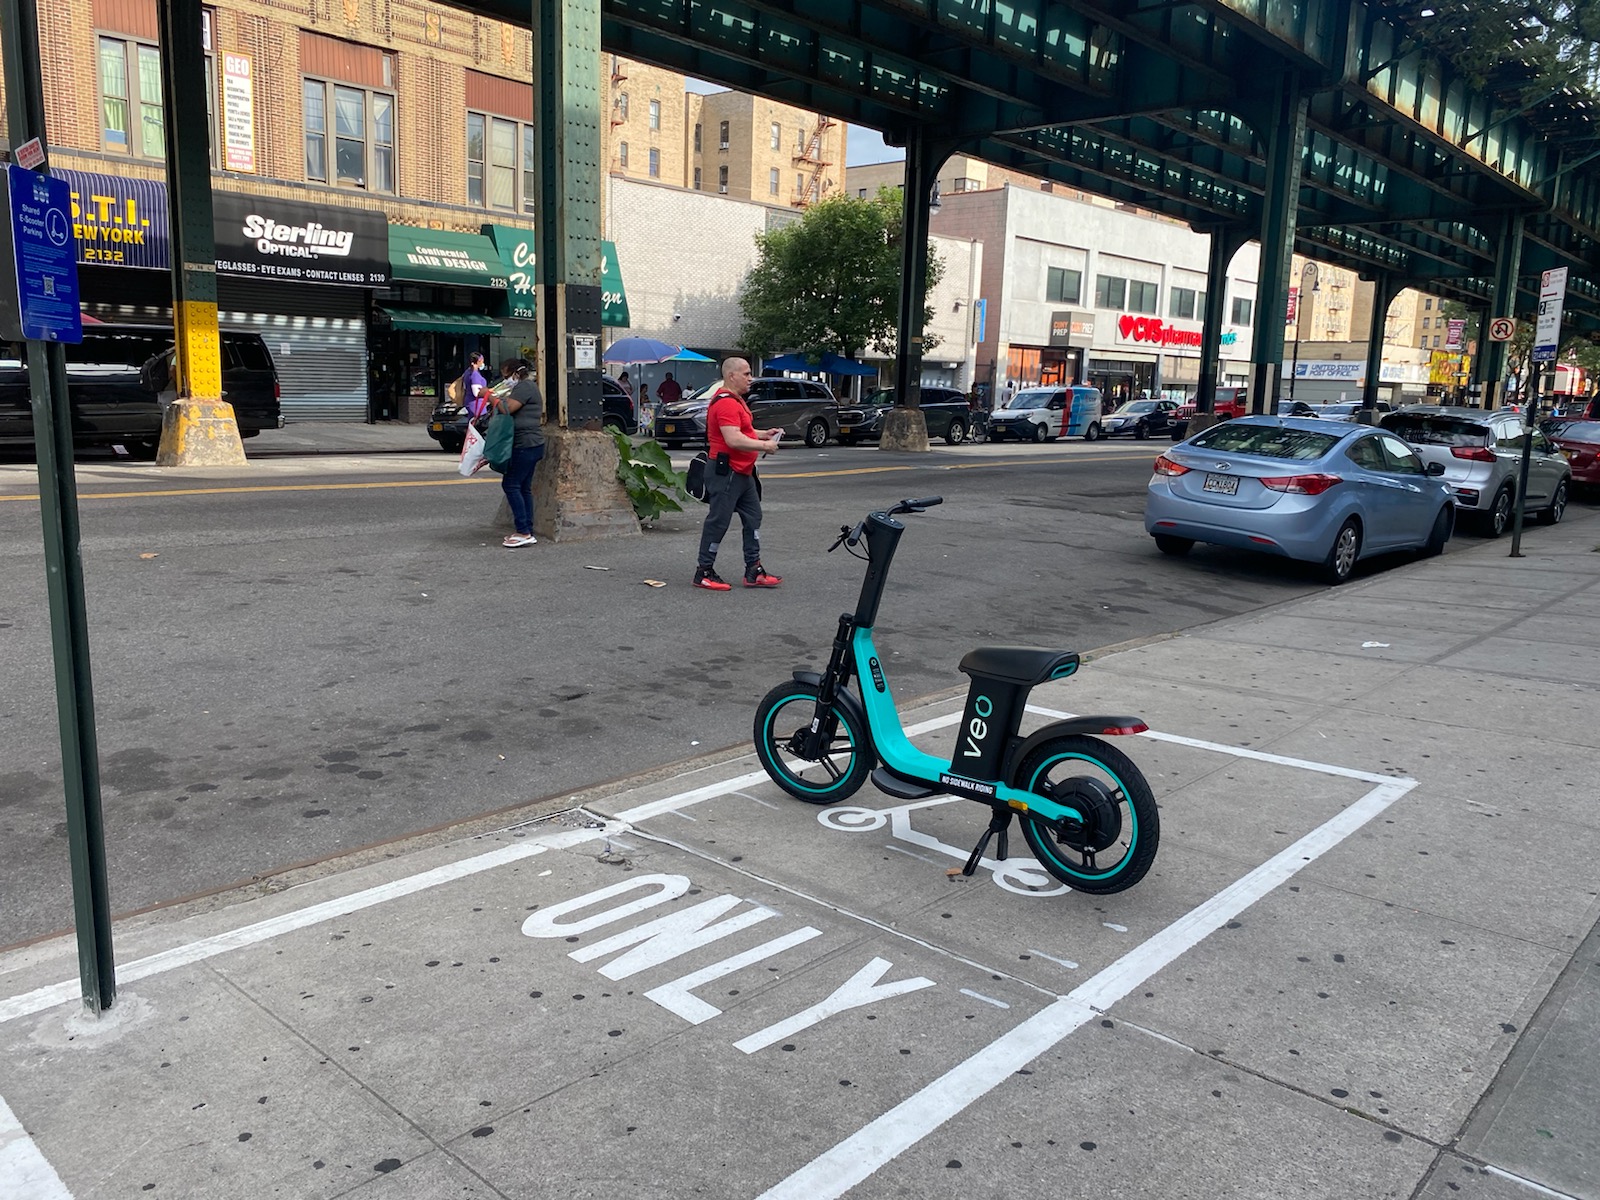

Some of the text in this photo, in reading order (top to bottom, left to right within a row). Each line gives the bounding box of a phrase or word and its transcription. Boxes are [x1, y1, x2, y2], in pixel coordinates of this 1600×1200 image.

[226, 56, 250, 76] GEO
[22, 204, 40, 216] Shared
[19, 214, 45, 228] E-Scooter
[22, 226, 43, 239] Parking
[73, 224, 145, 245] EW YORK
[242, 214, 354, 257] Sterling
[85, 248, 124, 262] 2132
[258, 238, 313, 258] OPTICAL
[416, 246, 470, 259] Continental
[214, 260, 256, 272] EGLASSES
[261, 266, 276, 274] EYE
[276, 267, 301, 277] EXAMS
[306, 270, 338, 280] CONTACT
[338, 272, 364, 282] LENSES
[406, 254, 488, 271] HAIR DESIGN
[370, 273, 386, 282] 2130
[514, 308, 532, 318] 2128
[1132, 316, 1164, 343] CVS
[1162, 325, 1202, 346] pharma
[942, 776, 993, 794] NO SIDEWALK RIDING
[522, 874, 937, 1055] ONLY
